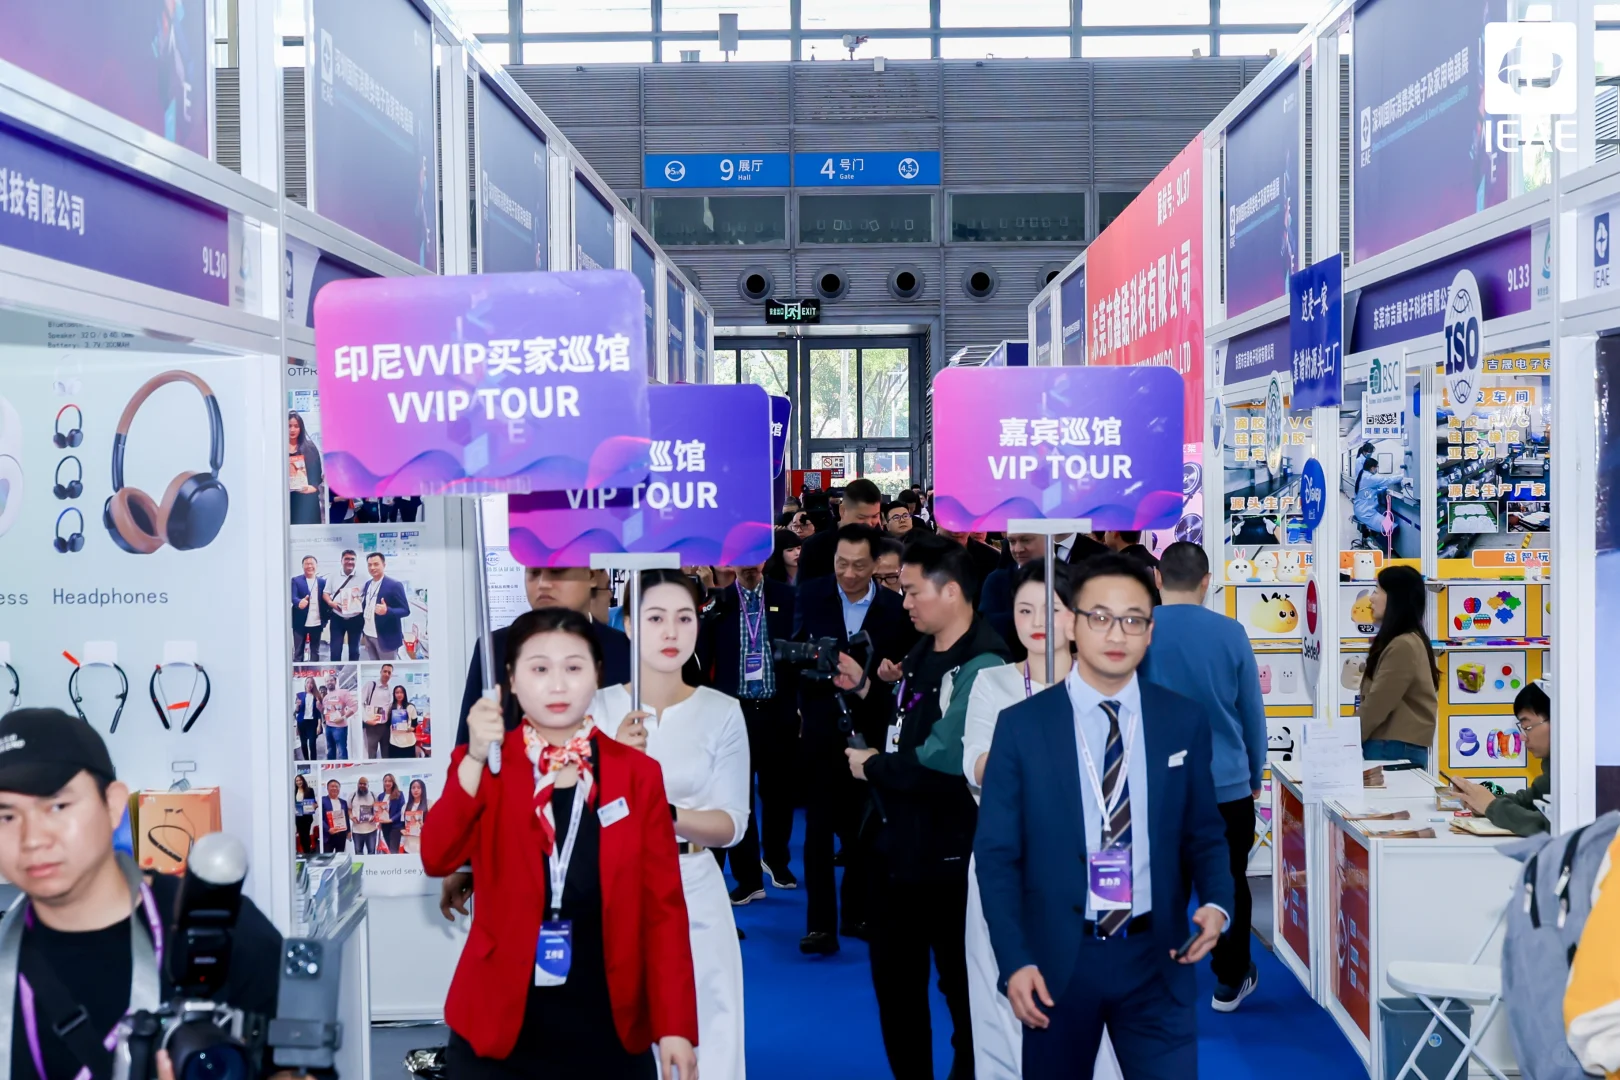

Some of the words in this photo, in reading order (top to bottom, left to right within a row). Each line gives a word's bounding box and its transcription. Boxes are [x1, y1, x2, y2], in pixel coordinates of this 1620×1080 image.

[1372, 46, 1469, 133] 深圳国际消费类电子及家用电器展
[720, 159, 734, 181] 9
[738, 160, 763, 172] 展厅
[820, 158, 835, 180] 4
[840, 159, 864, 171] 号门
[0, 167, 84, 235] 科技有限公司
[202, 246, 227, 280] 9L30
[1508, 263, 1530, 293] 9L33
[1593, 267, 1610, 290] IEAE
[801, 307, 816, 316] EXIT
[1301, 281, 1329, 322] 这是一家
[1445, 316, 1480, 374] ISO
[334, 333, 630, 383] 印尼VVIP买家巡馆
[1482, 358, 1551, 371] 吉晟电子科
[387, 389, 470, 424] VVIP
[476, 384, 581, 421] TOUR
[999, 416, 1122, 447] 嘉宾巡馆
[1234, 416, 1265, 430] 滴胶
[1234, 433, 1265, 446] 硅胶
[1448, 431, 1478, 444] 硅胶
[1489, 431, 1520, 444] 橡胶
[1448, 446, 1496, 460] 亚克力
[988, 455, 1038, 481] VIP
[1046, 454, 1133, 480] TOUR
[632, 481, 718, 510] TOUR
[1447, 483, 1547, 498] 源头生产厂家
[1230, 496, 1304, 511] 源头生产
[1503, 552, 1550, 564] 益智玩
[0, 592, 29, 605] ess
[53, 588, 169, 608] Headphones
[366, 868, 378, 876] the
[380, 867, 402, 876] world
